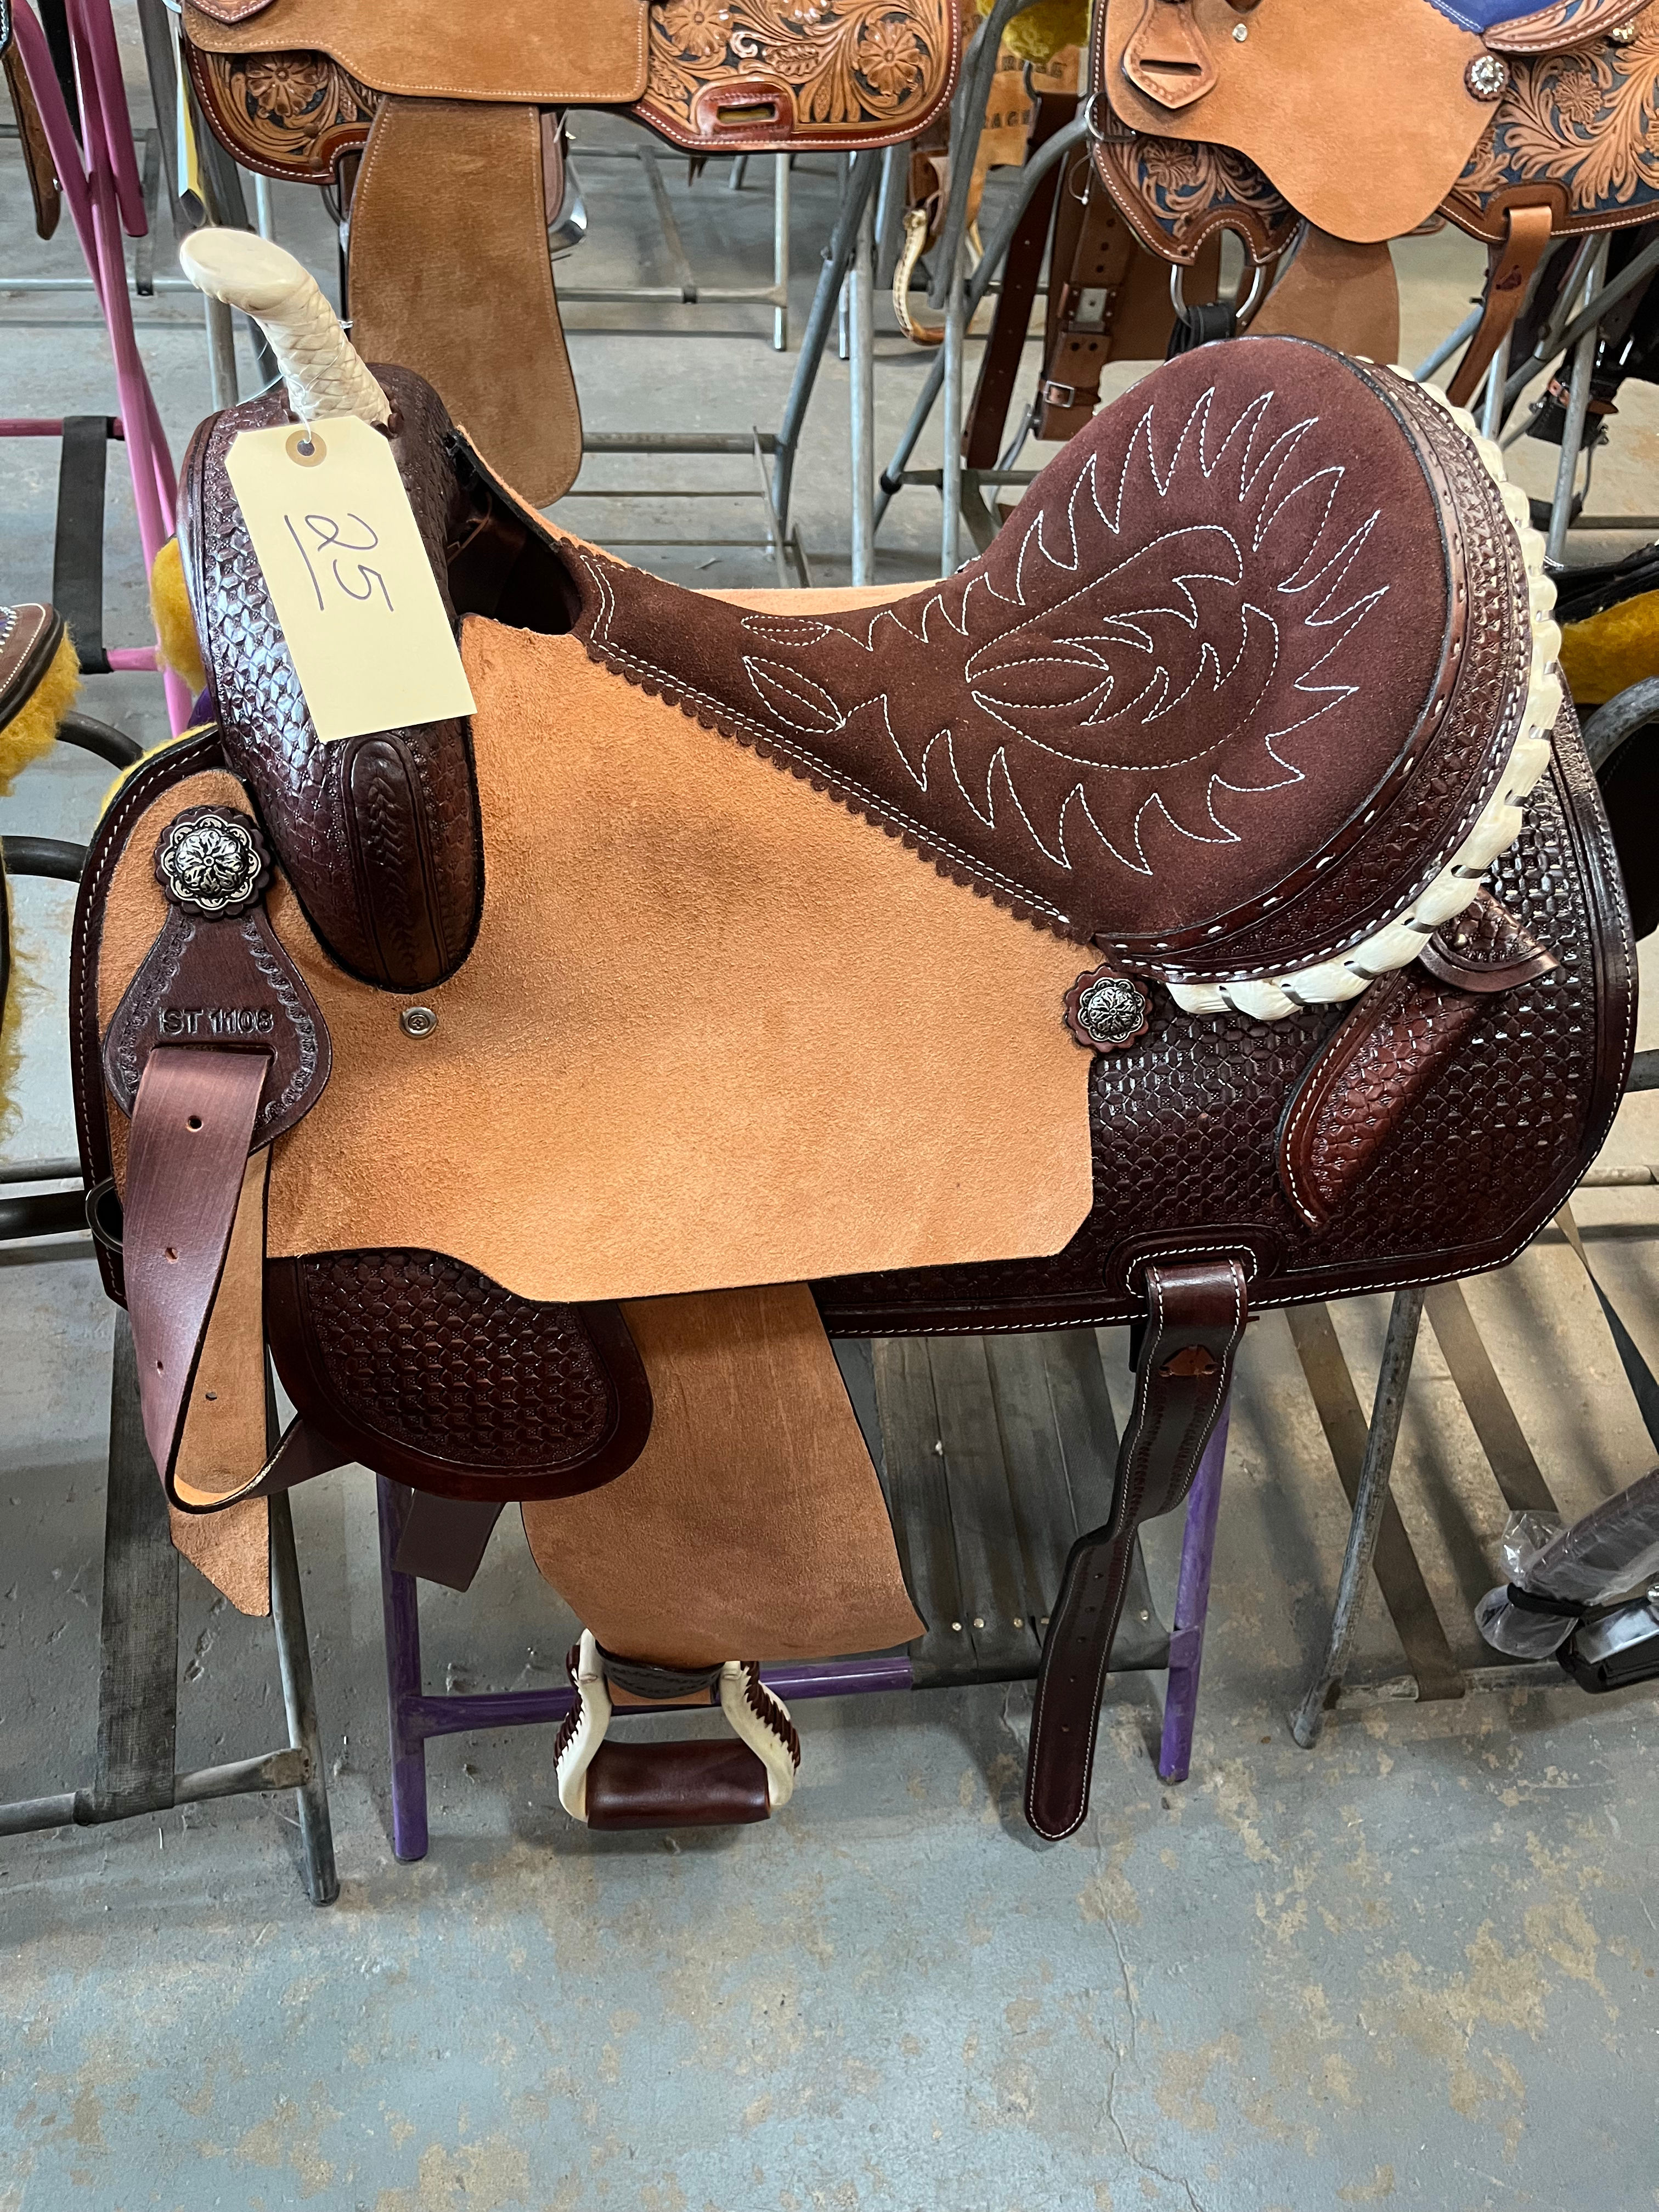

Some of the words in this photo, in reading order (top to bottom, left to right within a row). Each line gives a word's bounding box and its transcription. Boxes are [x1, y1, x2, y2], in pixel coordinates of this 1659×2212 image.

[304, 513, 394, 612] 25
[162, 1008, 204, 1035] ST
[209, 1008, 274, 1035] 1108
